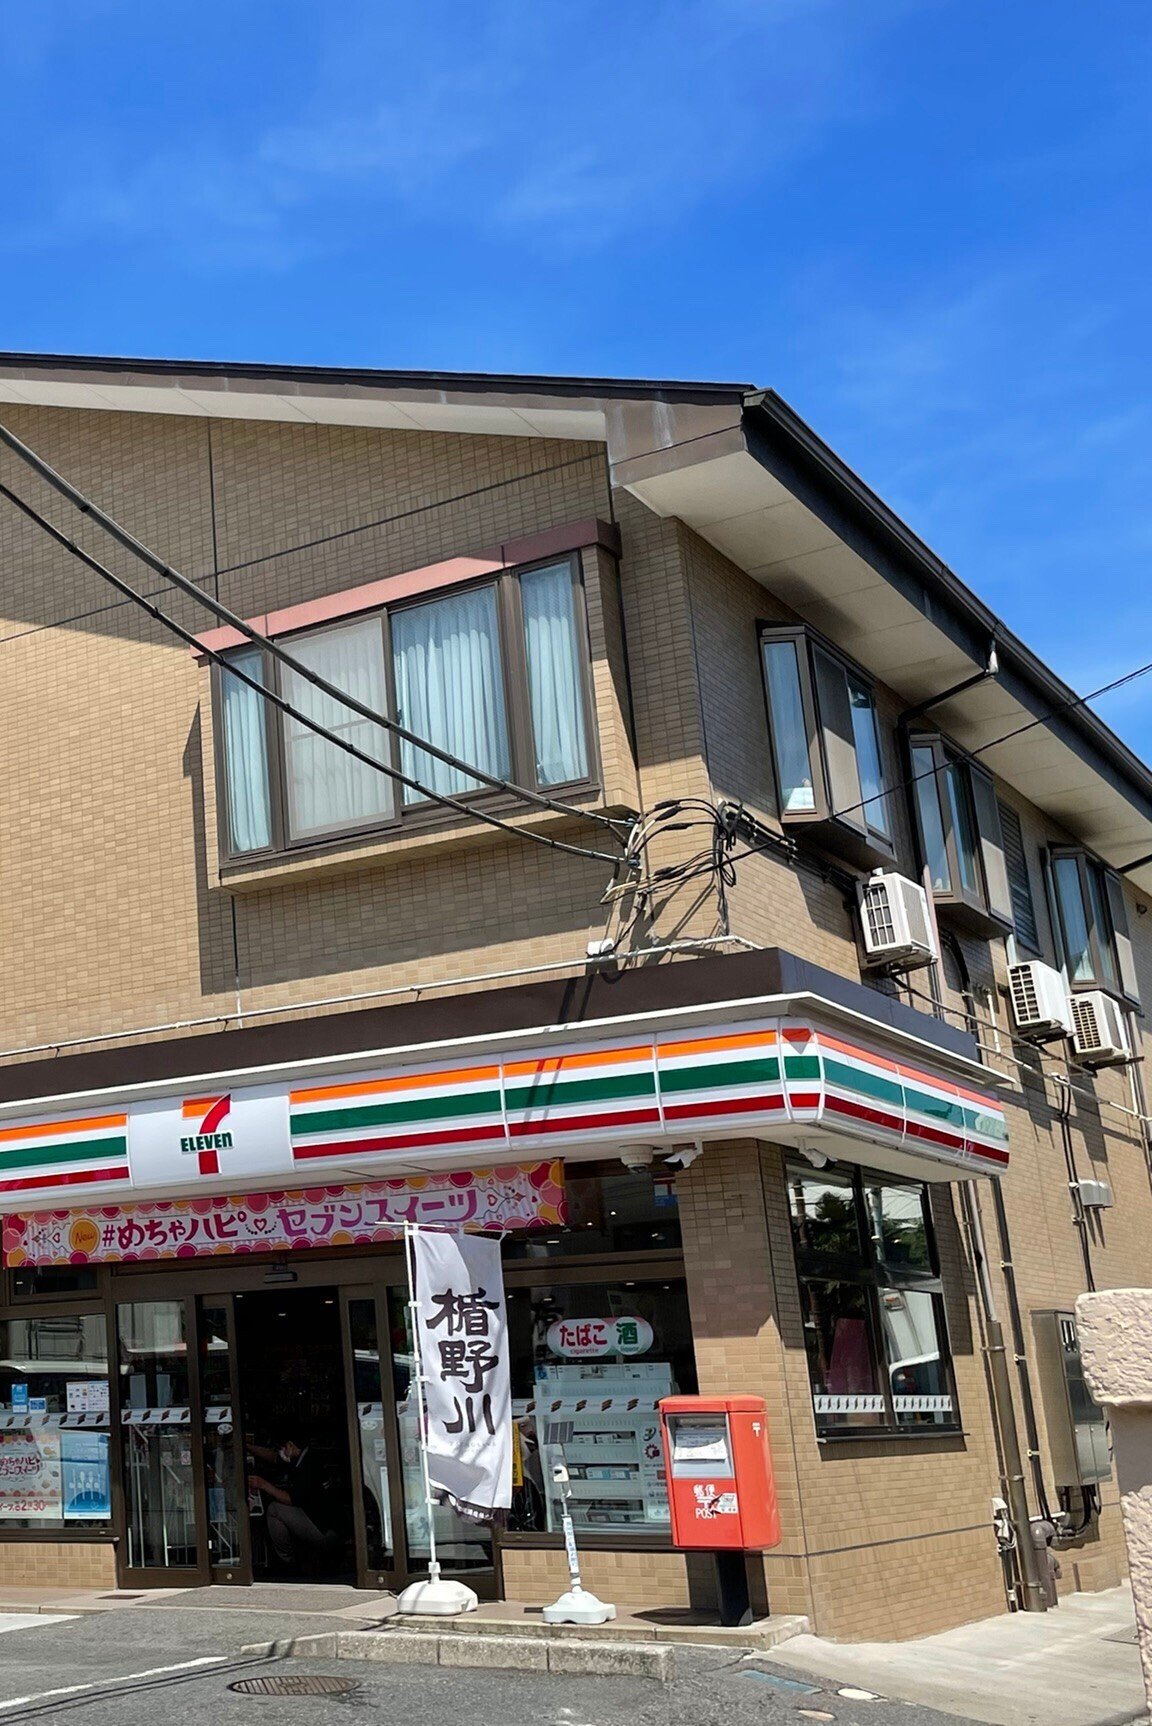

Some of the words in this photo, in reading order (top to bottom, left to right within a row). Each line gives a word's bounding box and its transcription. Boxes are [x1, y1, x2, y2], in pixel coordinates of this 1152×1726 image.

[181, 1093, 232, 1175] 7
[559, 1323, 608, 1347] たばこ
[616, 1322, 639, 1345] 酒
[425, 1287, 500, 1436] 楯野川
